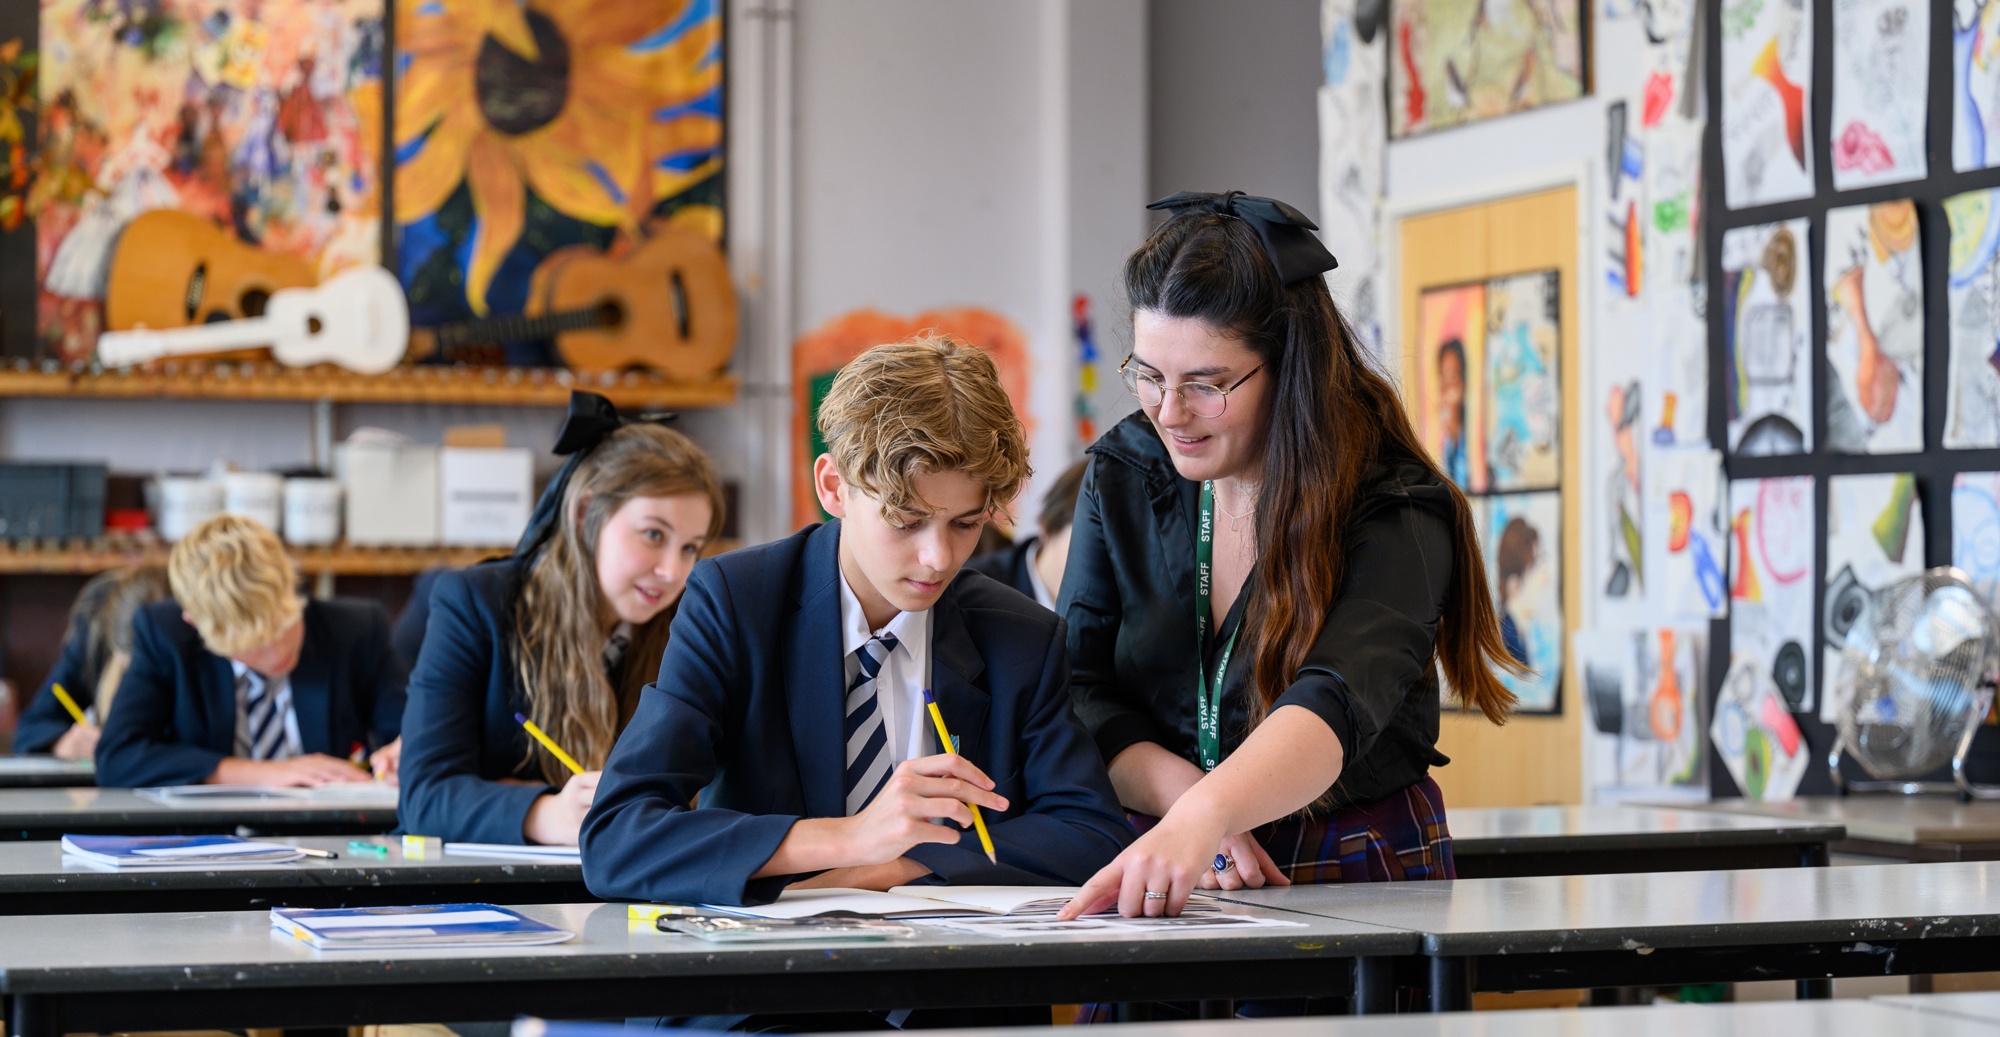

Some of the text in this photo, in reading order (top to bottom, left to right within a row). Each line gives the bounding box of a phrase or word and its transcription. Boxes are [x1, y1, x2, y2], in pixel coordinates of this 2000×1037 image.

[1201, 509, 1210, 542] STAFF
[1200, 562, 1209, 596] STAFF
[1217, 651, 1230, 685] STAFF
[1200, 695, 1209, 730] STAFF
[1209, 705, 1218, 740] STAFF
